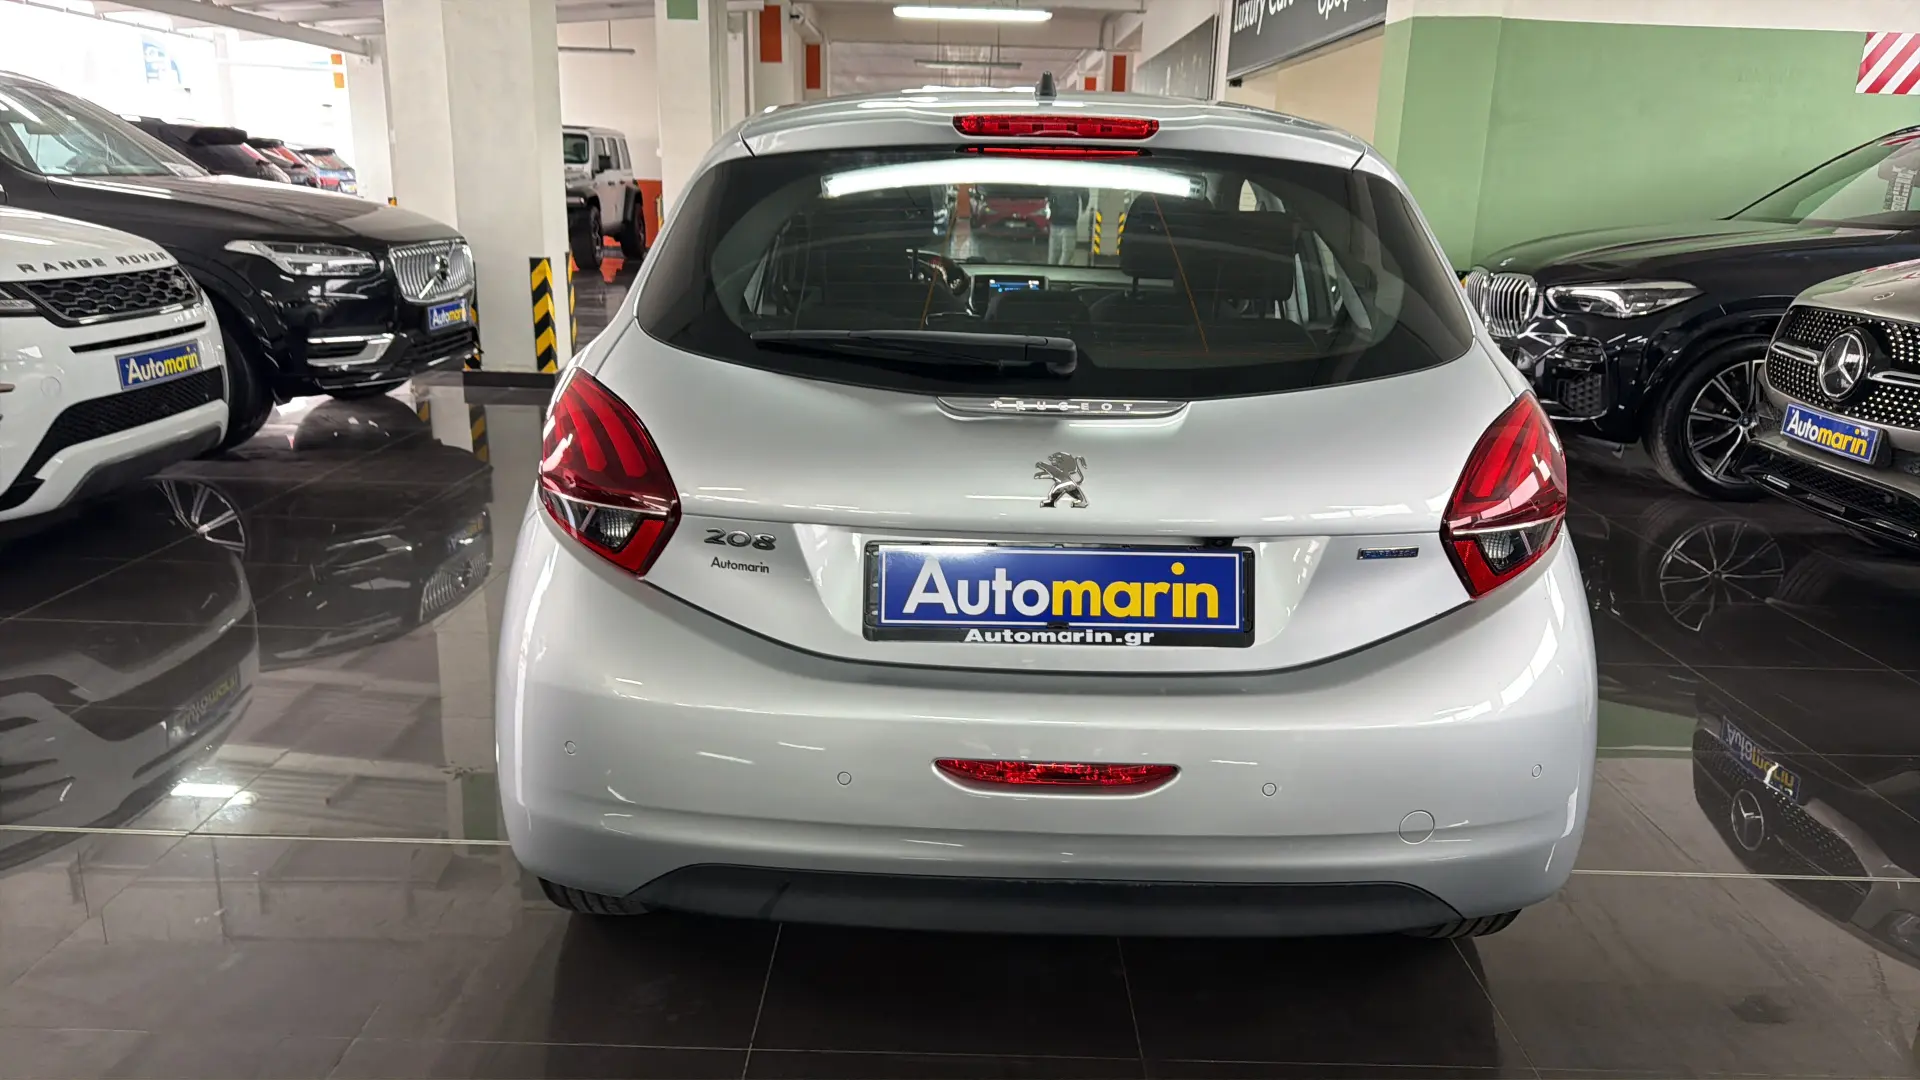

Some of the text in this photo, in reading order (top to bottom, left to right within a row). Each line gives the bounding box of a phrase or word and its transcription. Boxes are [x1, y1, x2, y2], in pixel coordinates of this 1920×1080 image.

[1268, 0, 1294, 15] Ca
[16, 251, 168, 274] RANGE ROVER
[432, 307, 467, 327] Automar
[128, 346, 199, 384] Automarin
[992, 400, 1133, 411] PEUGEOT
[1786, 409, 1868, 457] Automarin
[703, 527, 777, 551] 208
[711, 556, 770, 574] Automarin
[902, 560, 1219, 619] Automarin
[963, 628, 1155, 646] Automarin.gr
